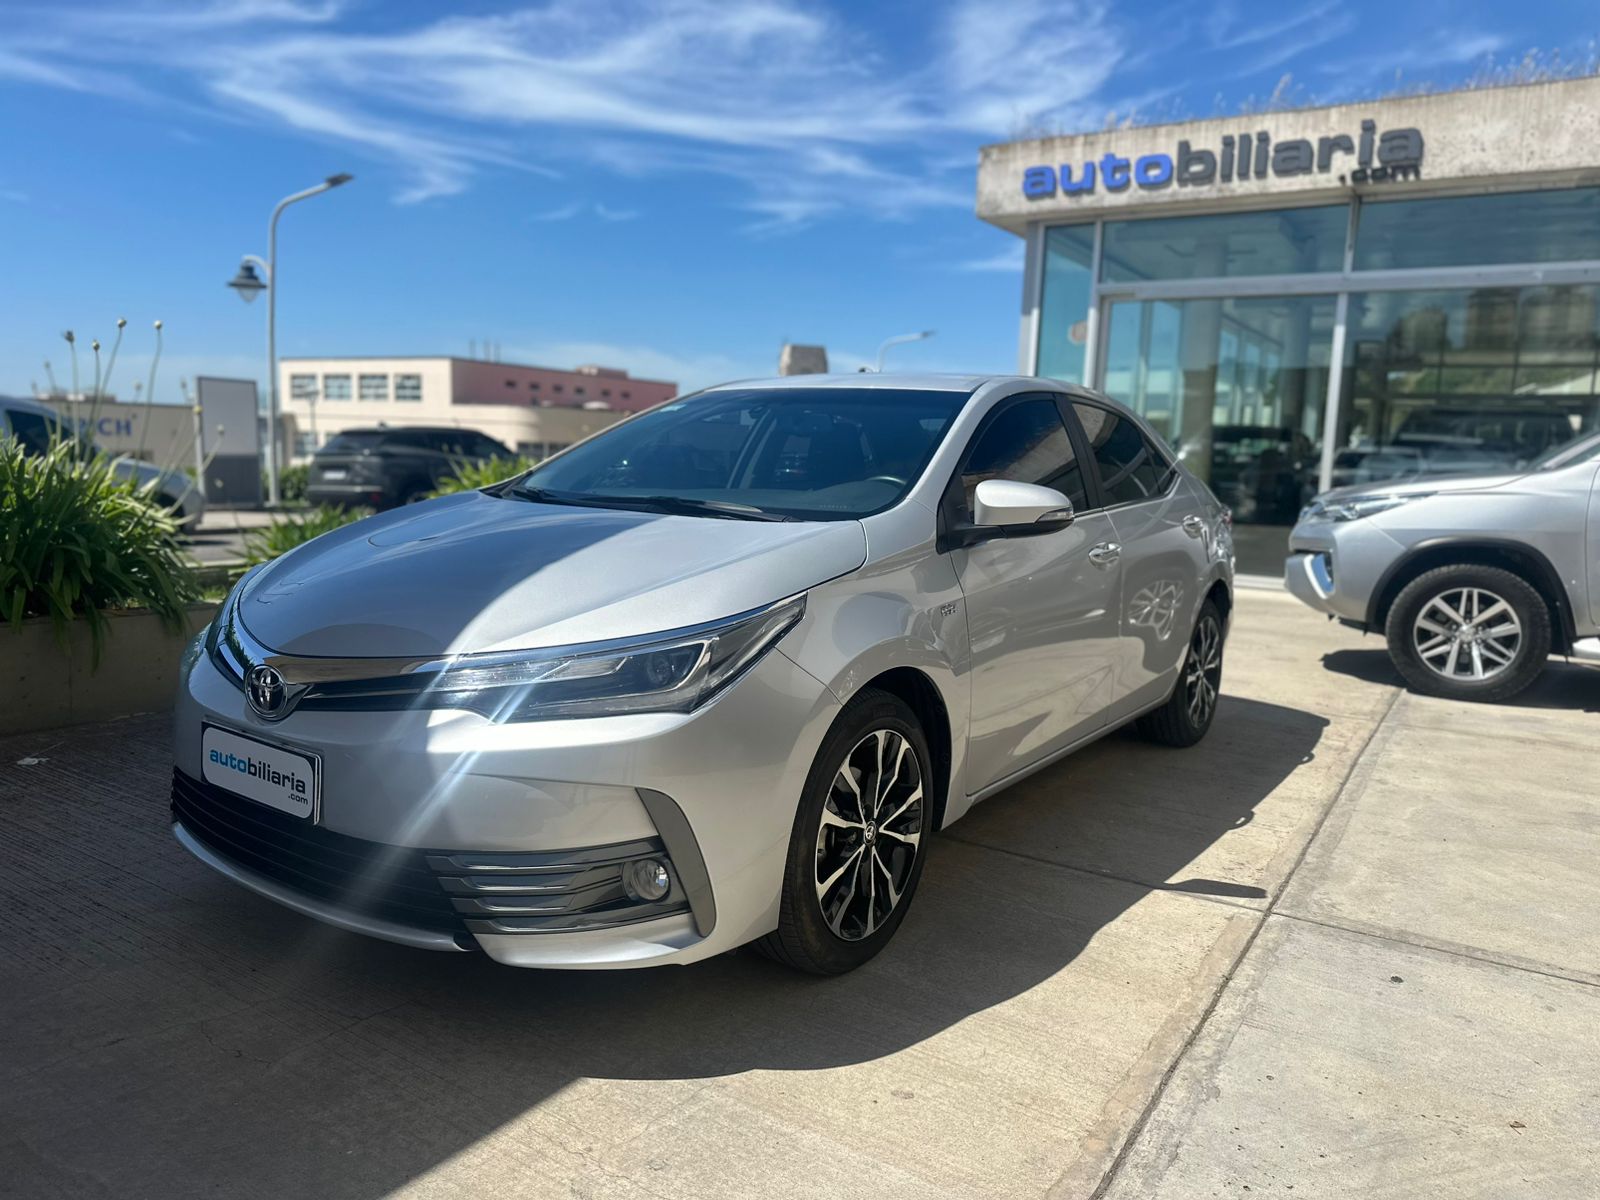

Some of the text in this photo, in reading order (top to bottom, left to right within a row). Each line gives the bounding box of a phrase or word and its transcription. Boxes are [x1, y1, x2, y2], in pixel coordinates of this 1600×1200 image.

[1023, 119, 1424, 199] autobiliaria
[1339, 166, 1420, 184] .com
[209, 749, 306, 795] autobiliaria
[288, 793, 309, 805] .com
